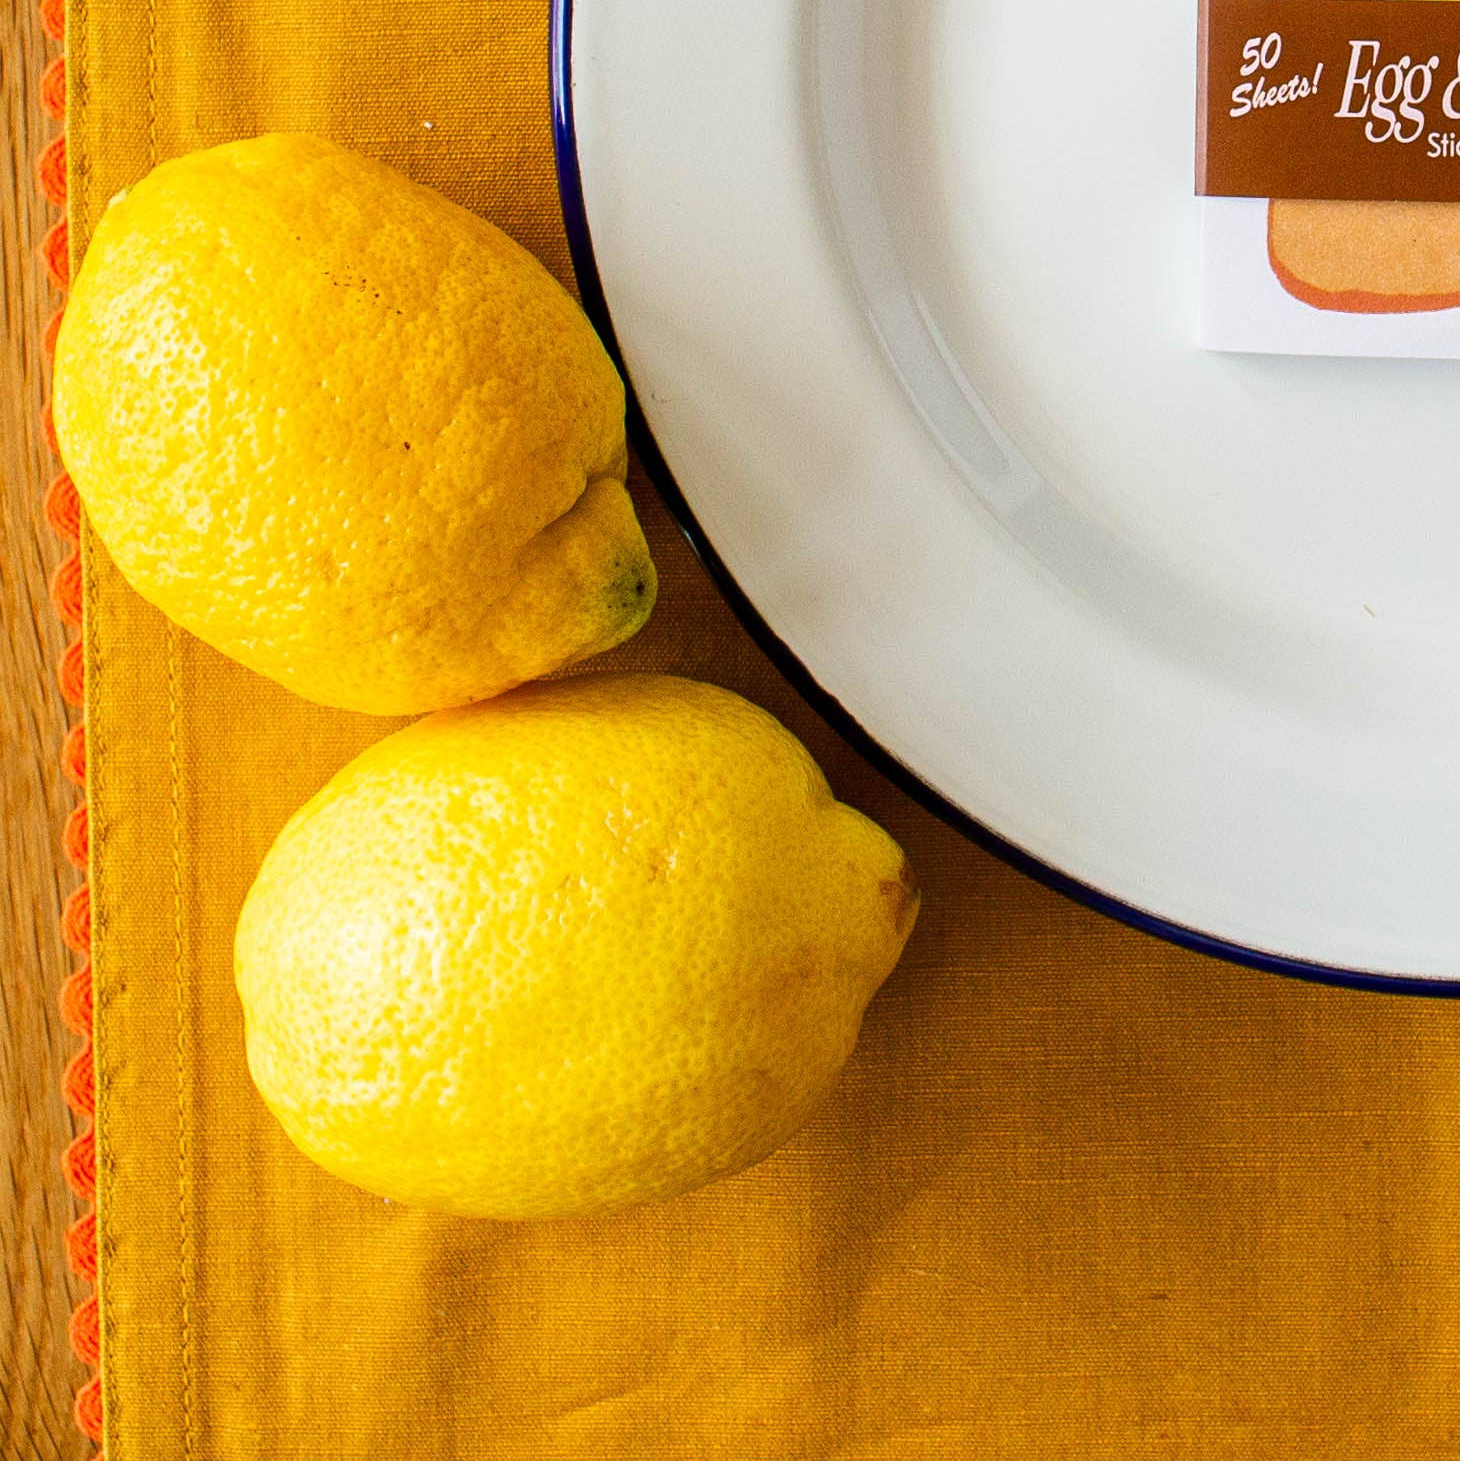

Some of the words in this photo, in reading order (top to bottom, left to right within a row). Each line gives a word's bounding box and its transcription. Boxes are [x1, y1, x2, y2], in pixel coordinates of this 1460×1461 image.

[1239, 32, 1282, 76] 50
[1229, 63, 1324, 118] Sheets!
[1334, 39, 1439, 142] Egg
